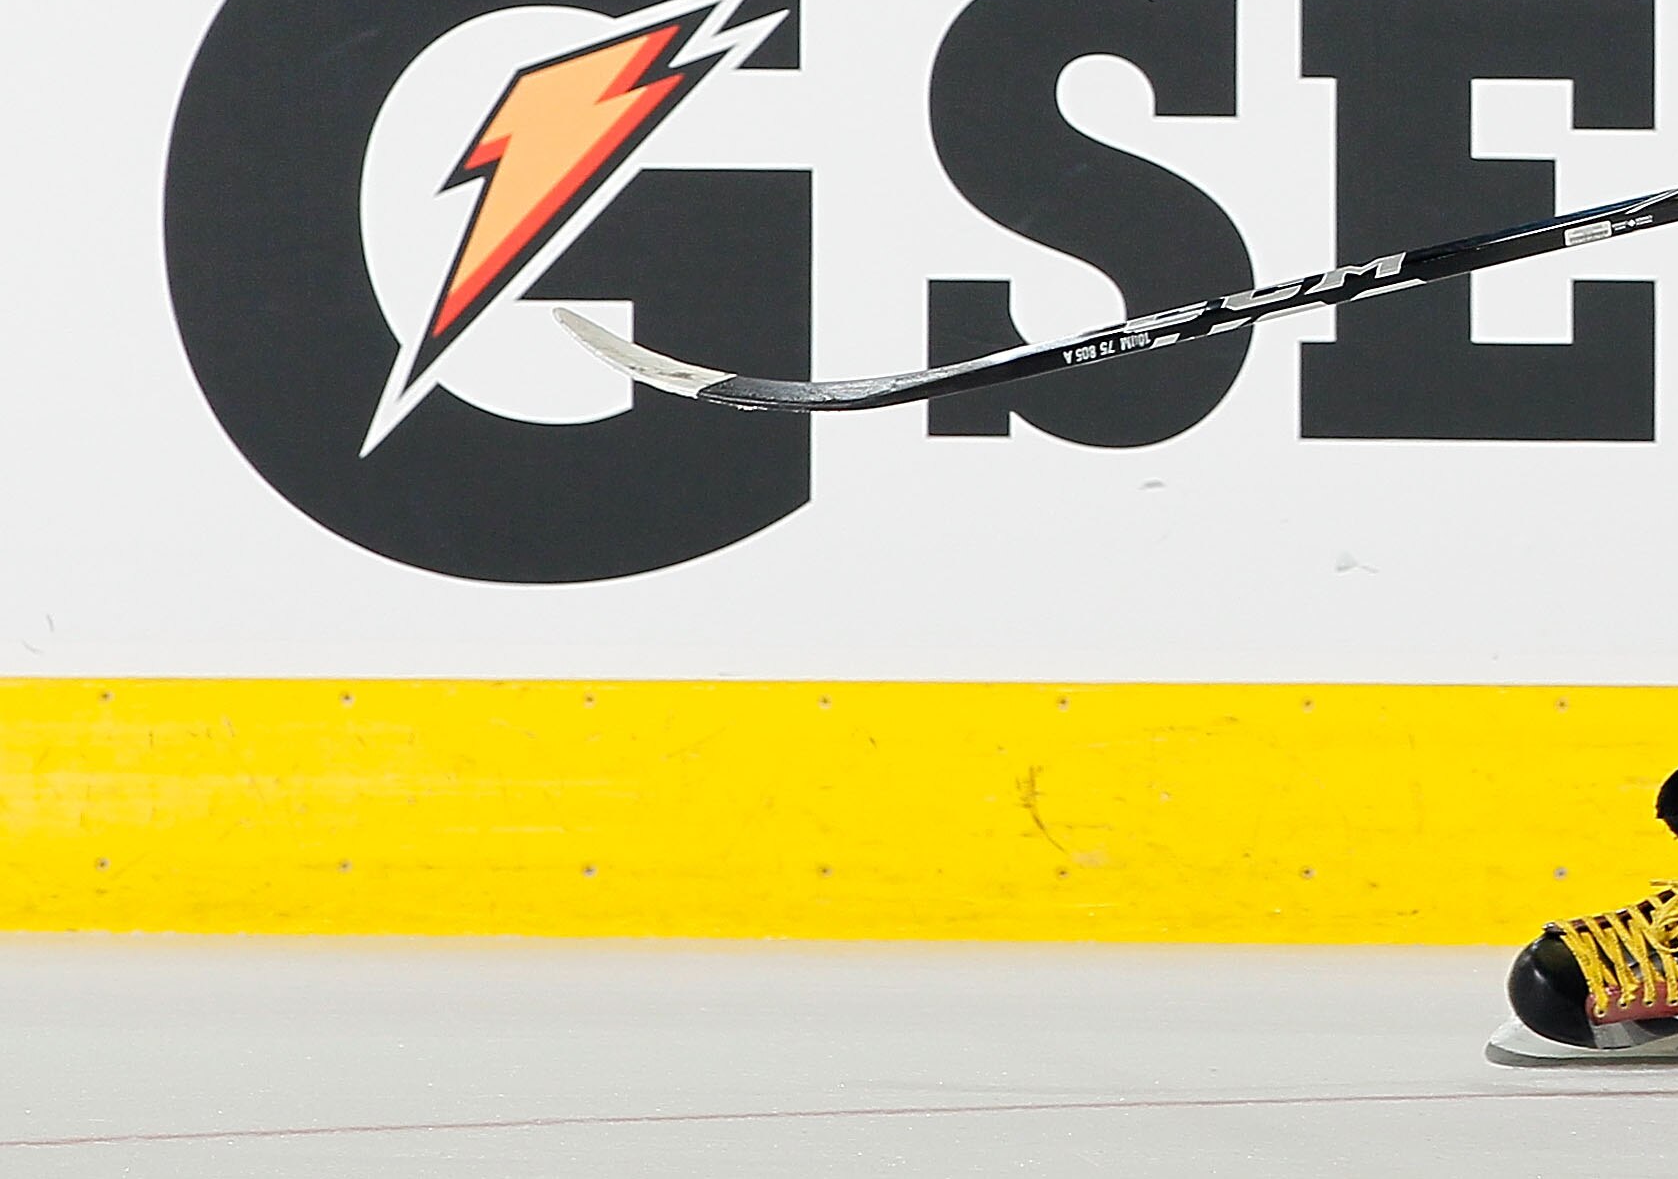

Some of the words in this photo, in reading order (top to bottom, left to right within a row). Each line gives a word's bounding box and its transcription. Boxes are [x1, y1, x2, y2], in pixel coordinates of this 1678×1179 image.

[1063, 350, 1073, 364] A
[1075, 346, 1096, 362] 805
[1100, 343, 1116, 357] 75
